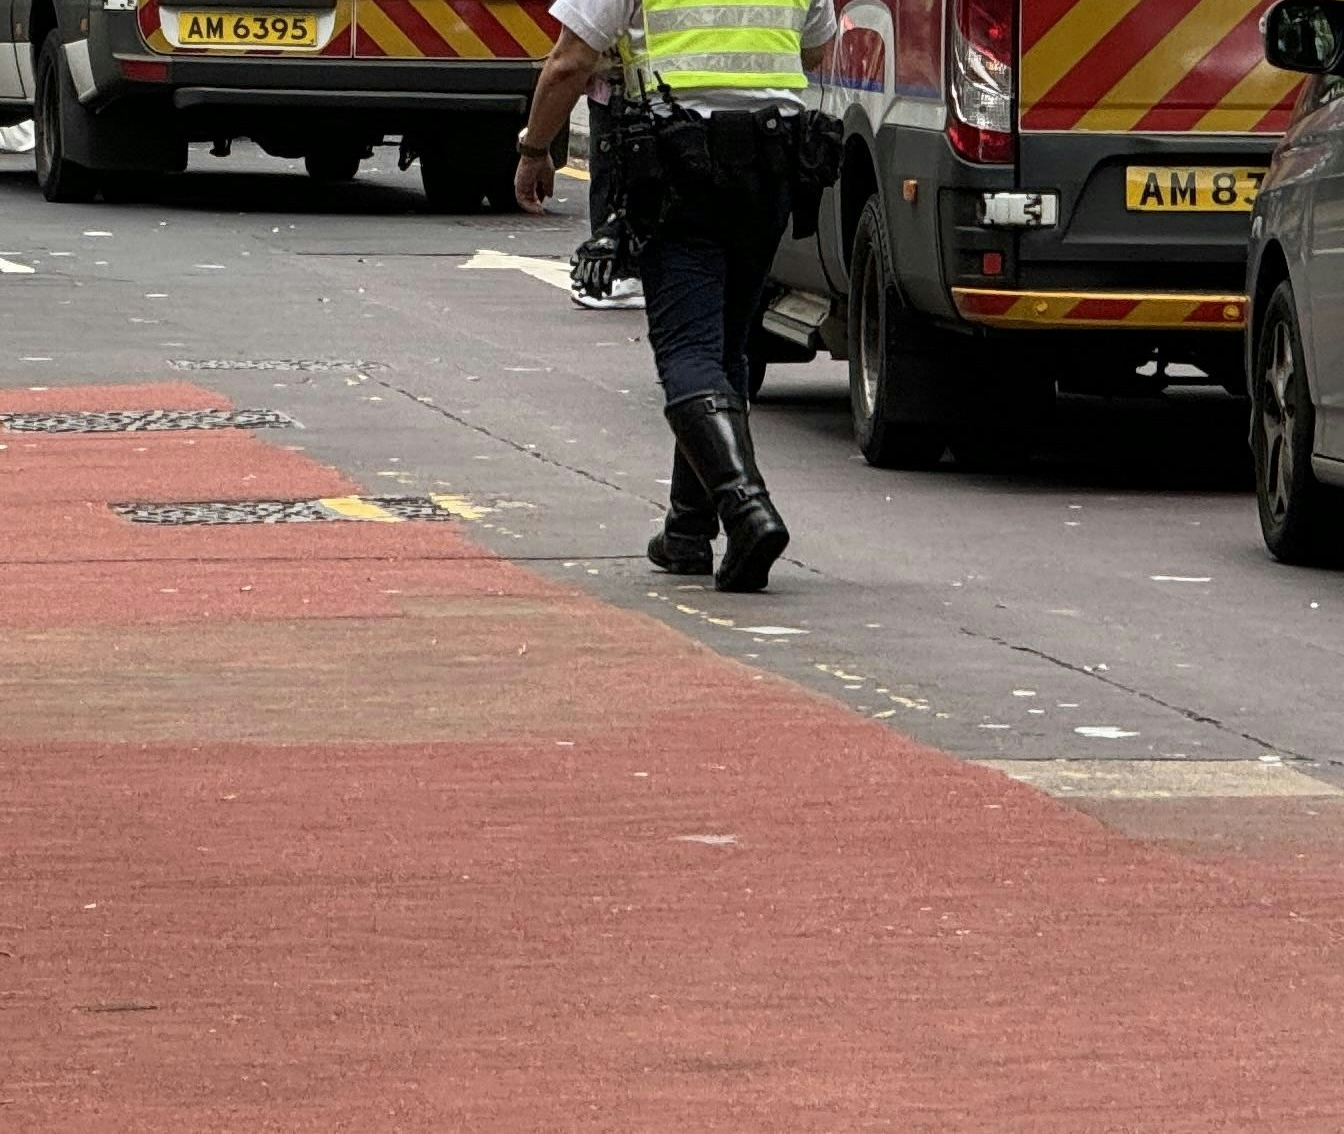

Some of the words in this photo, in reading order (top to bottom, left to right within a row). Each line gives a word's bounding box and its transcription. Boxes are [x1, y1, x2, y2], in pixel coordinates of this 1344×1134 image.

[187, 15, 224, 39] AM
[233, 17, 308, 40] 6395
[1140, 172, 1197, 206] AM
